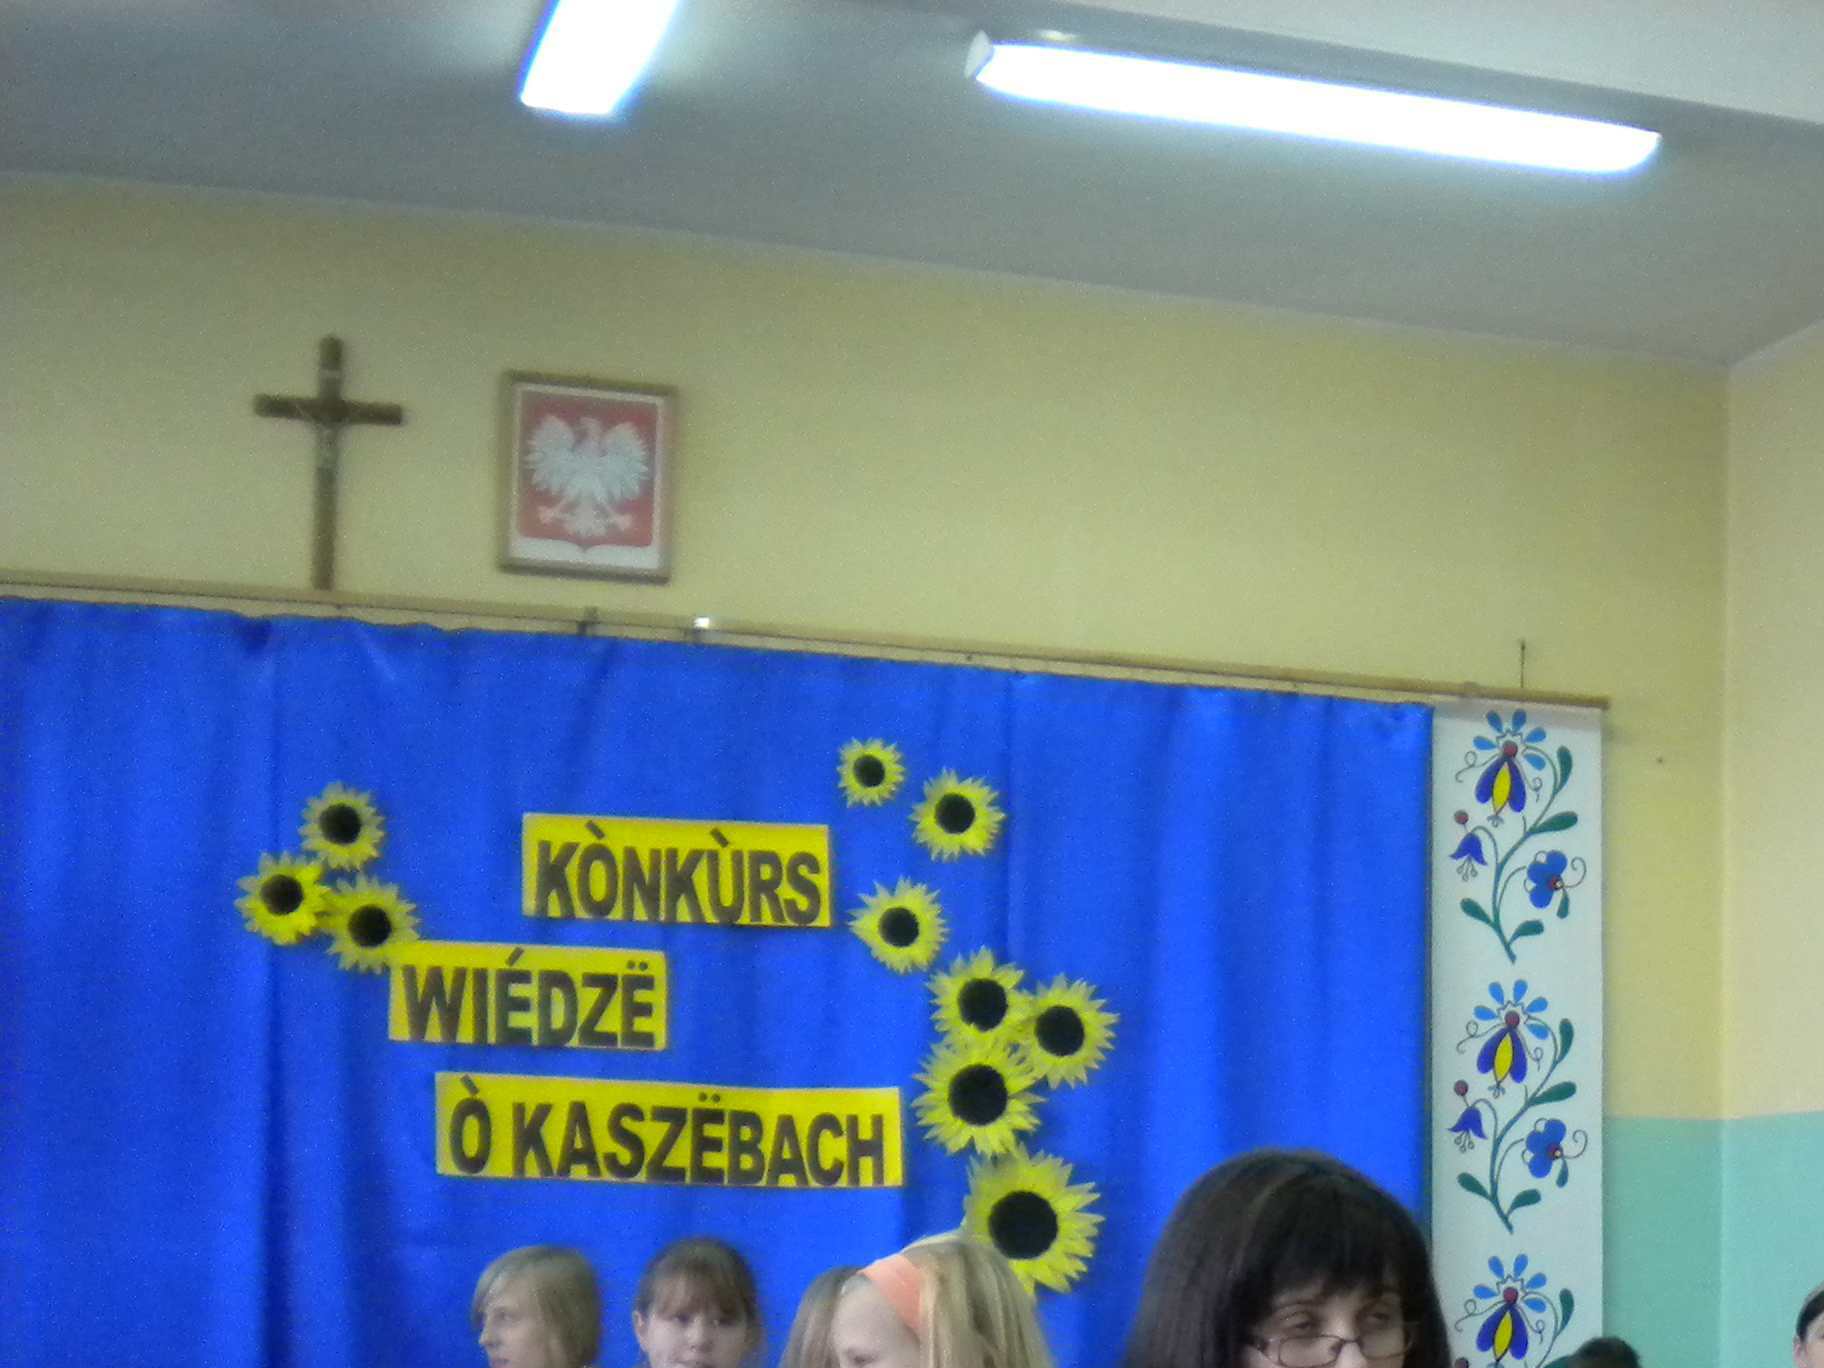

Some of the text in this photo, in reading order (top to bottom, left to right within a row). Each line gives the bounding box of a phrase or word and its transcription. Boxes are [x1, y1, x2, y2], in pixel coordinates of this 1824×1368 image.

[535, 820, 822, 926] KÒNKÙRS
[402, 948, 655, 1047] WIÉDZË
[449, 1075, 884, 1186] Ò KASZËBACH
